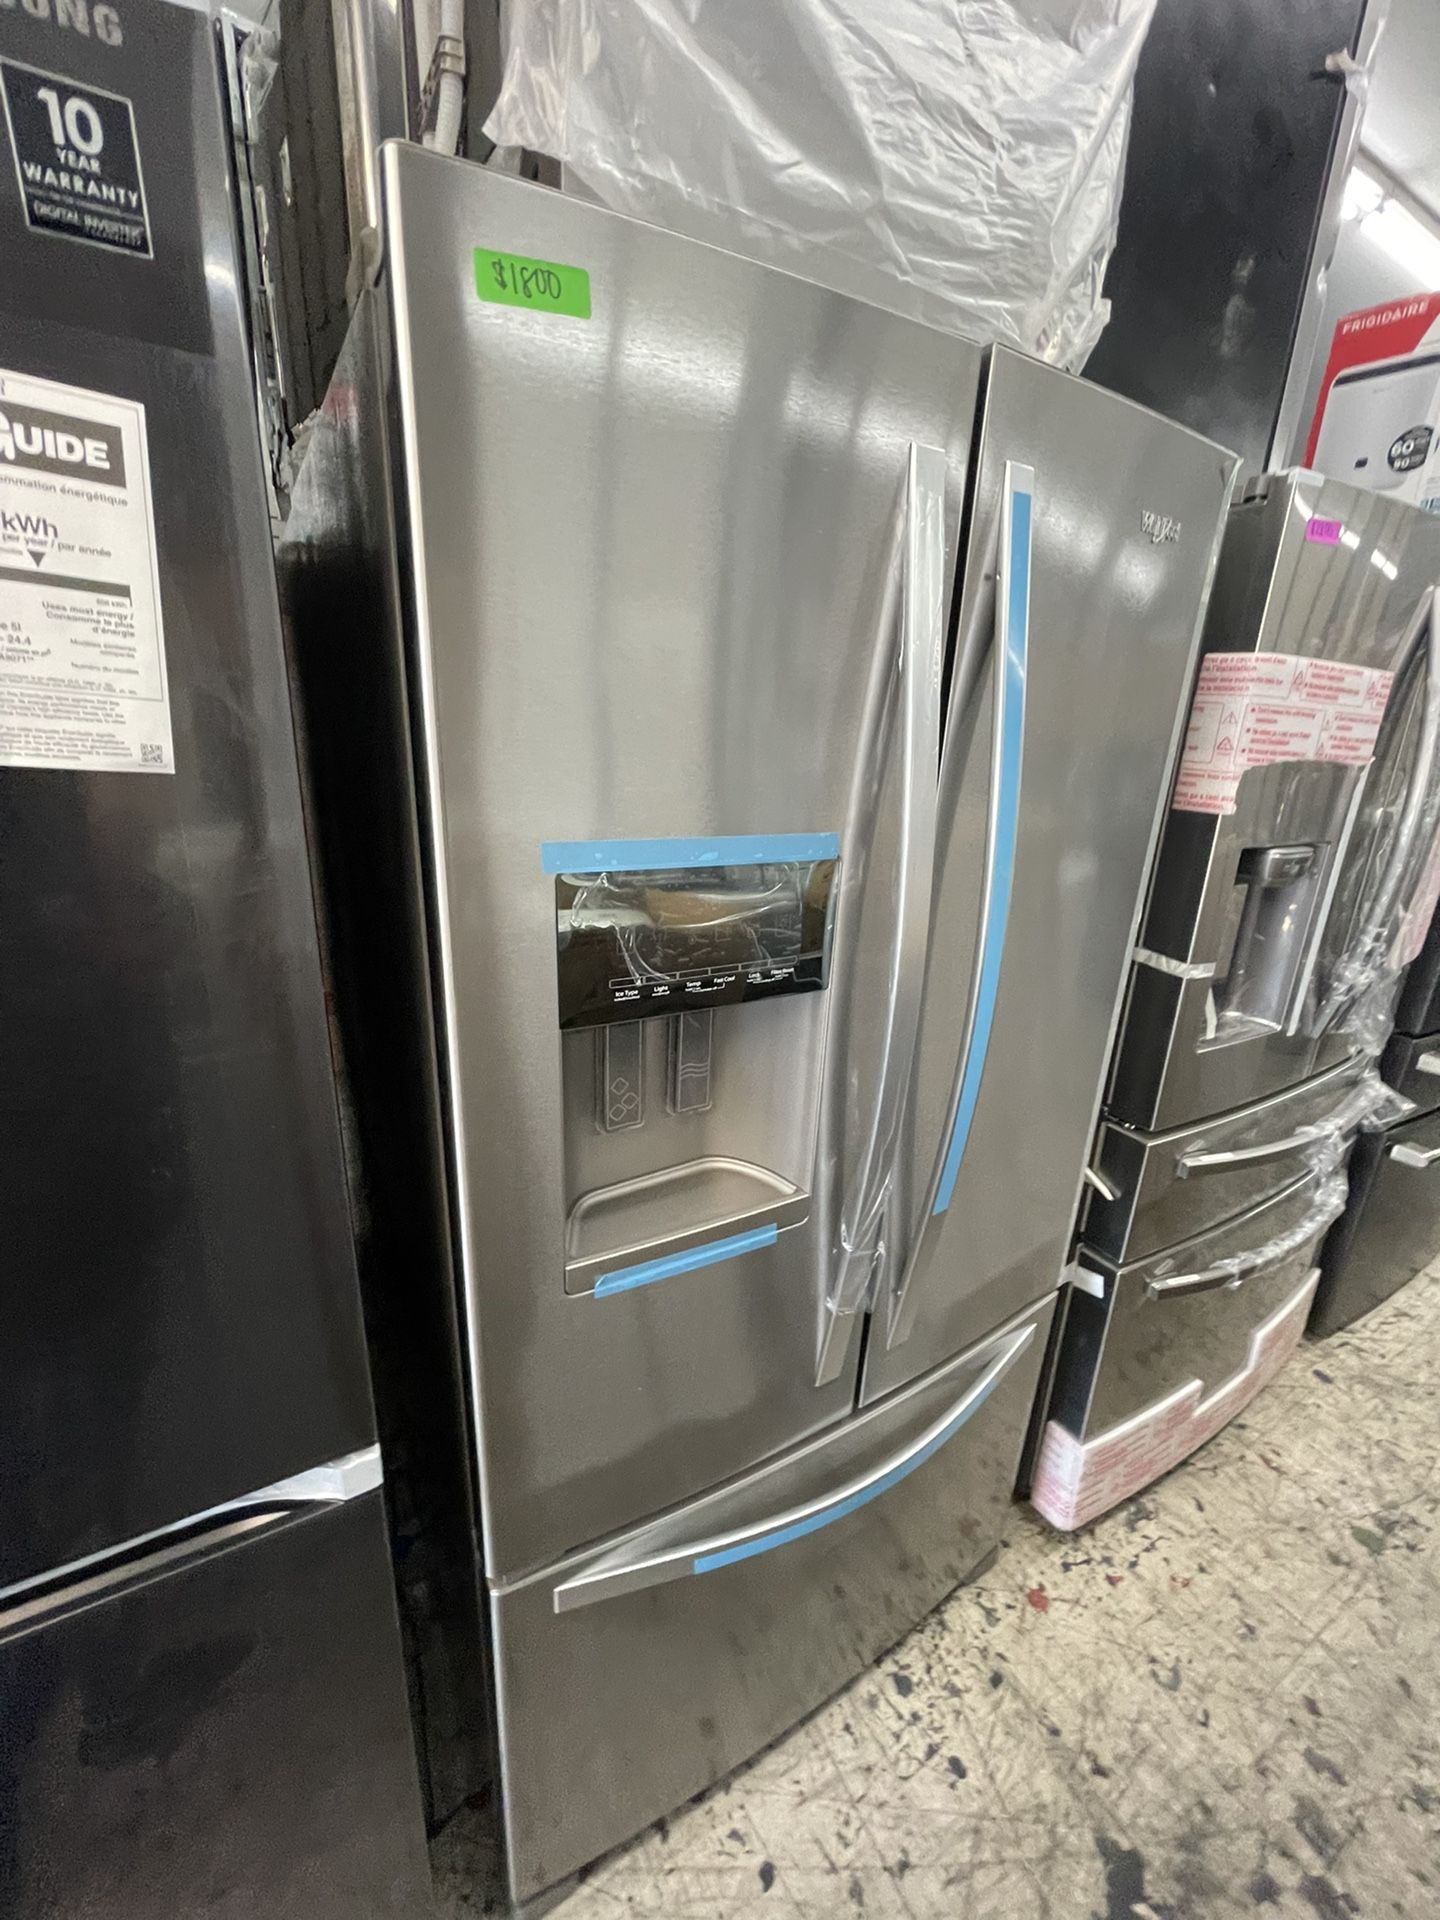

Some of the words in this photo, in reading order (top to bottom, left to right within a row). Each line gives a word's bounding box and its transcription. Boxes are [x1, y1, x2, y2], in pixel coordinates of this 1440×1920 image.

[37, 87, 104, 155] 10
[56, 147, 101, 174] YEAR
[23, 160, 138, 209] WARRANTY
[491, 258, 562, 300] $1800
[1342, 301, 1429, 335] FRIGIDAIRE
[60, 483, 128, 507] énergétique
[1, 509, 58, 539] kWh
[58, 541, 76, 551] par
[79, 545, 112, 558] année
[42, 600, 67, 613] Uses
[69, 606, 94, 615] most
[96, 608, 128, 620] energy
[625, 989, 639, 997] Type
[653, 985, 669, 993] Light
